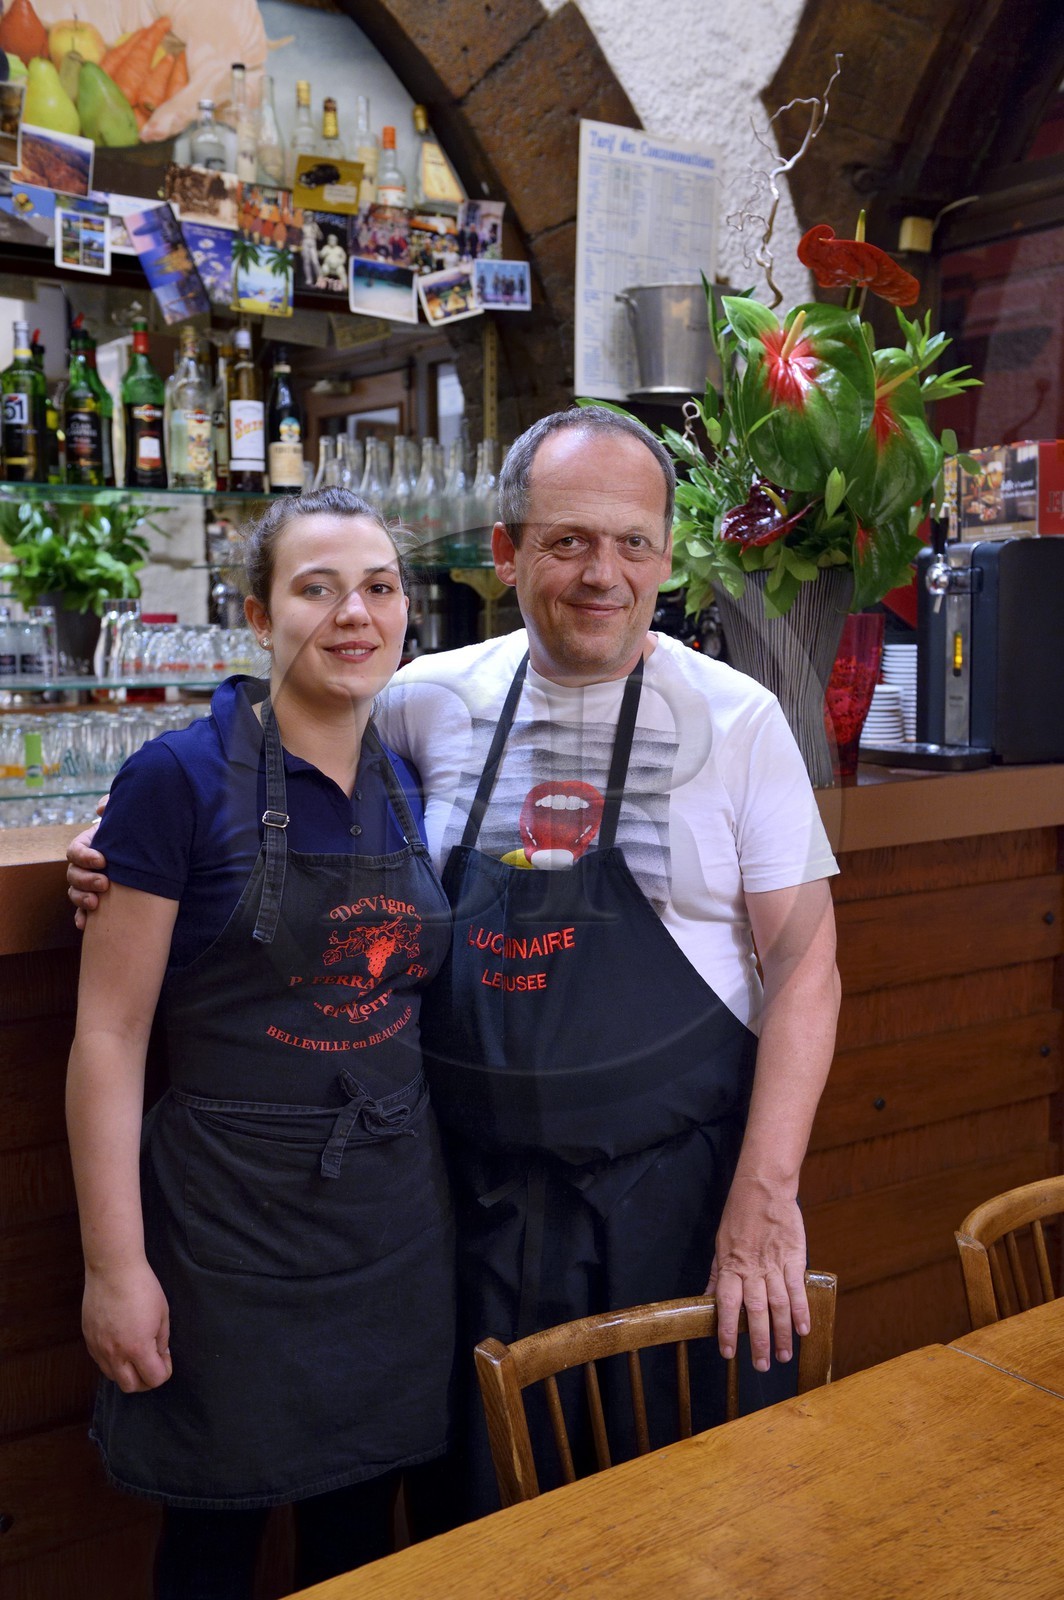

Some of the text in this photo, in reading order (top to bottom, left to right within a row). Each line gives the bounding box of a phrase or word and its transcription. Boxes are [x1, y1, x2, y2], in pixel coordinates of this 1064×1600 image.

[312, 975, 383, 990] FERRA
[266, 1024, 350, 1052] BELLEVILLE
[352, 1040, 367, 1050] en
